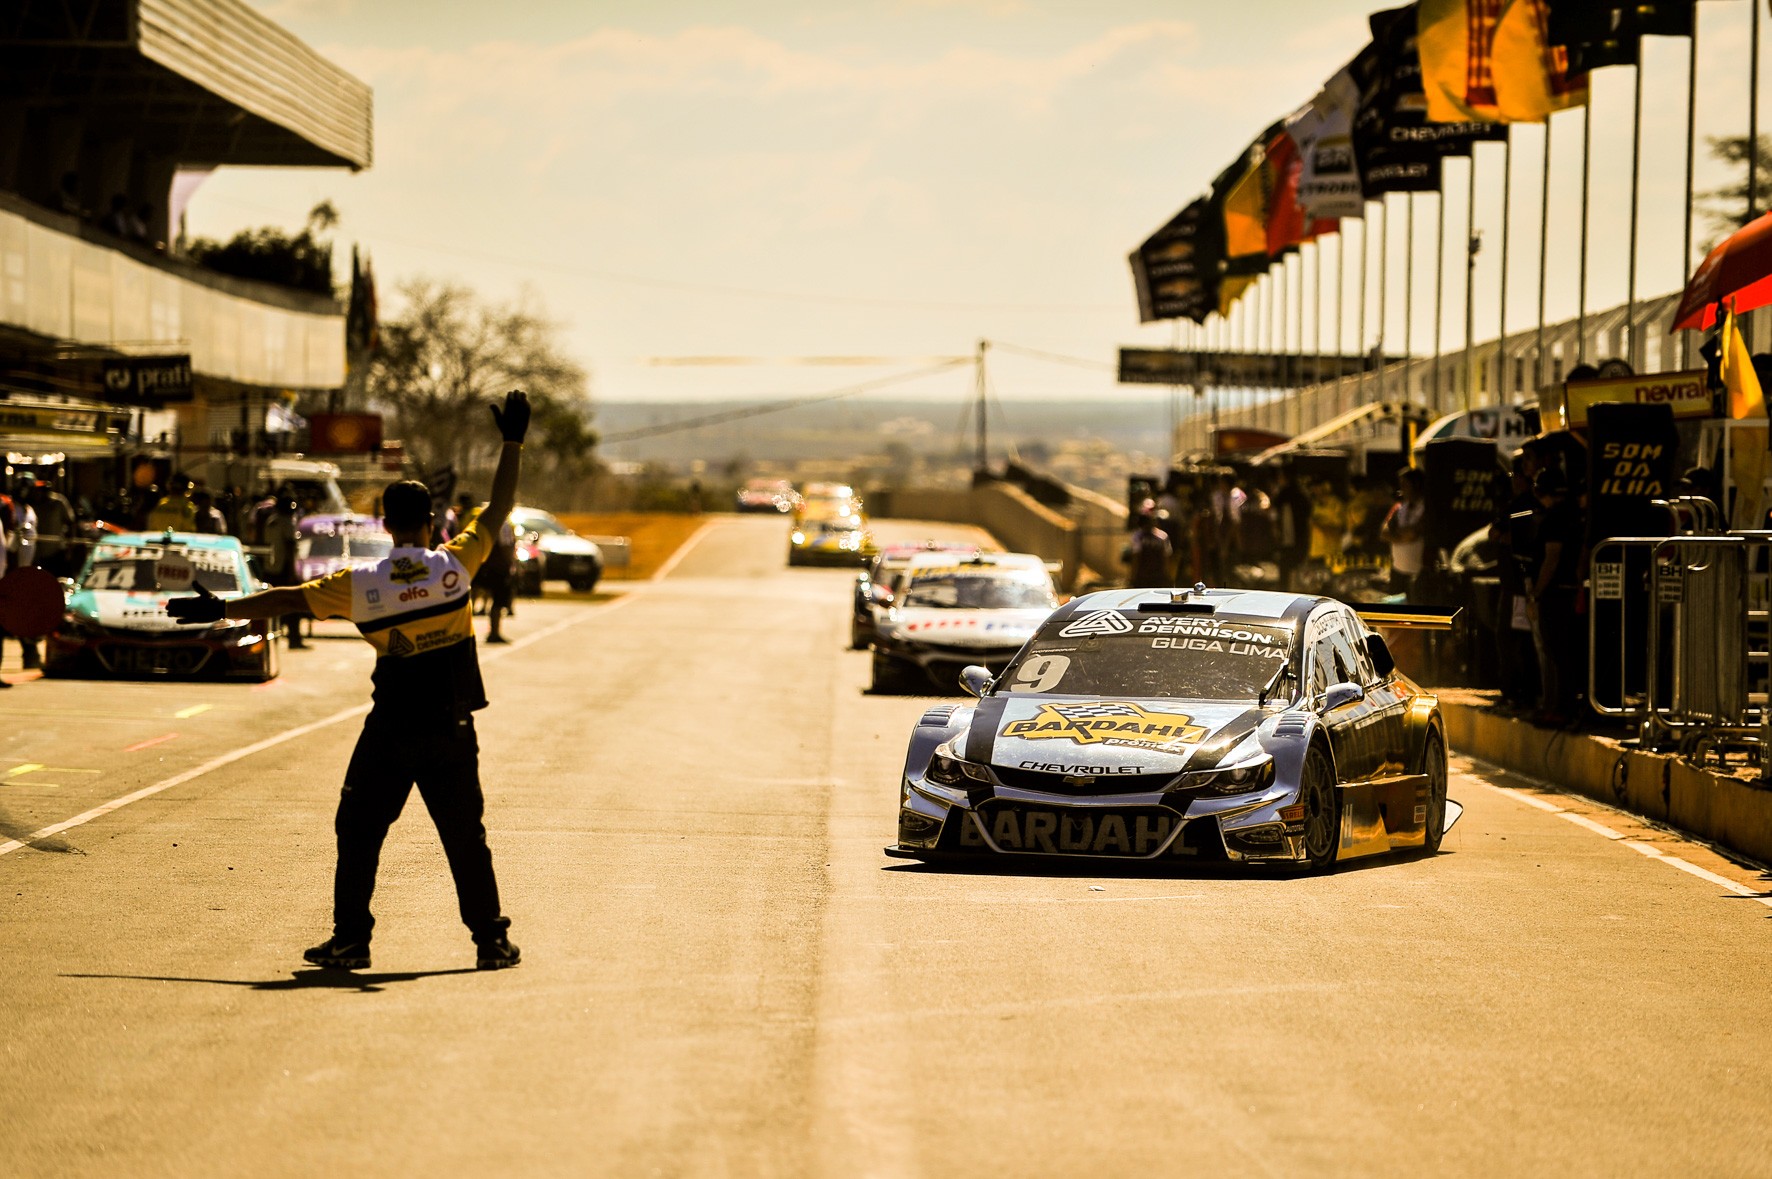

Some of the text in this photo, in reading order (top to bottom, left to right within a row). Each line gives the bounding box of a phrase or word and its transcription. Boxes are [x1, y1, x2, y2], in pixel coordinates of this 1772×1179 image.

[1603, 443, 1663, 460] SOM
[399, 586, 429, 602] elfa
[1142, 616, 1228, 628] AVERY
[416, 629, 447, 641] AVERY
[1138, 625, 1272, 644] DENNISON
[1152, 637, 1286, 660] GUGA LIMA
[1010, 655, 1071, 693] 9
[1011, 719, 1198, 740] BARDAHL
[1018, 760, 1145, 775] CHEVROLET
[960, 809, 1198, 855] BARDAHL
